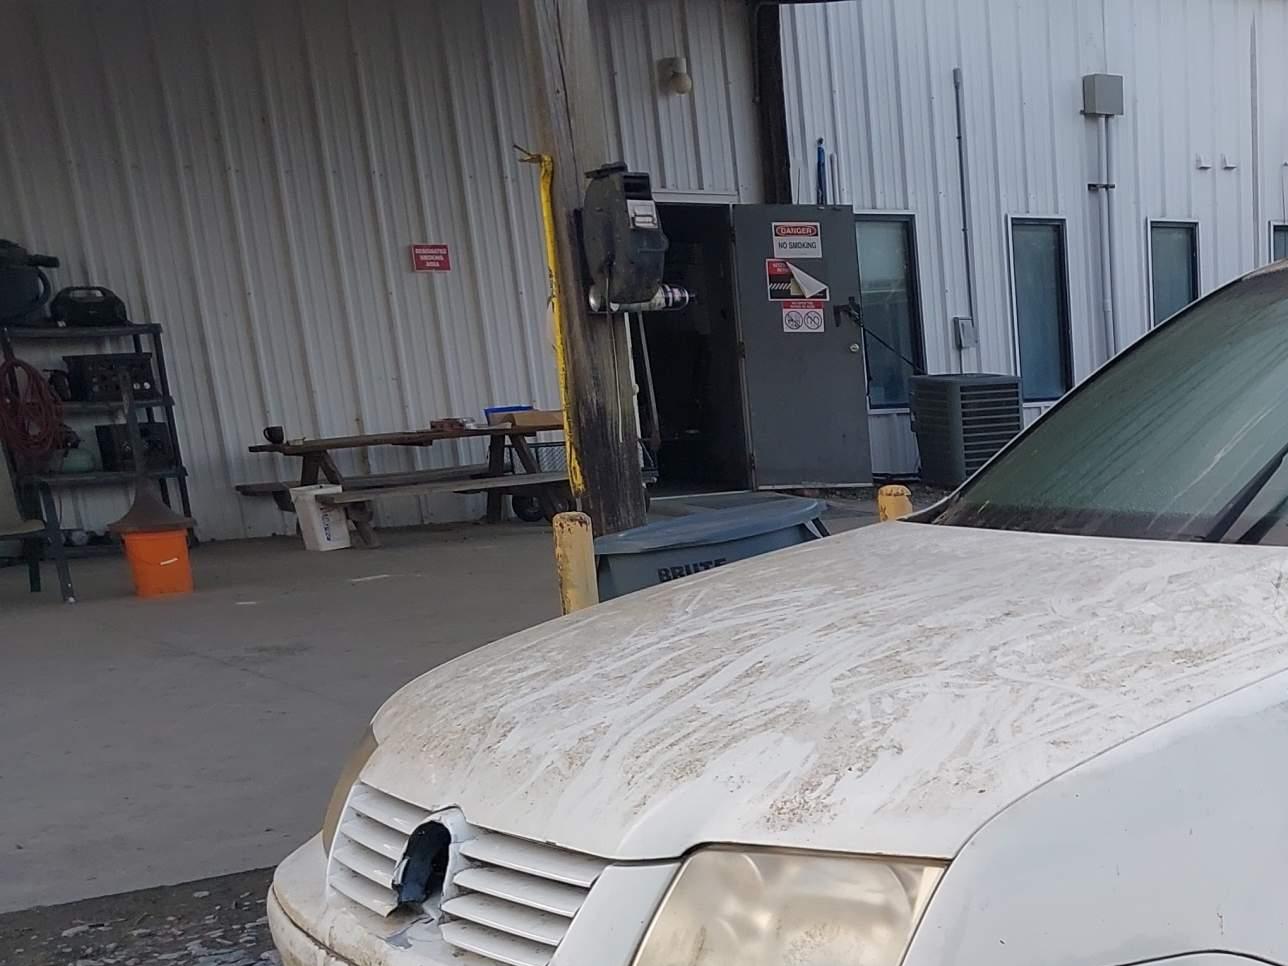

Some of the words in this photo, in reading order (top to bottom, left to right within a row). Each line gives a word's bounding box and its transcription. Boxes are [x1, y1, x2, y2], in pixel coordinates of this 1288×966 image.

[780, 226, 813, 235] DANGER
[778, 241, 788, 249] NO
[789, 241, 817, 249] SMOKING
